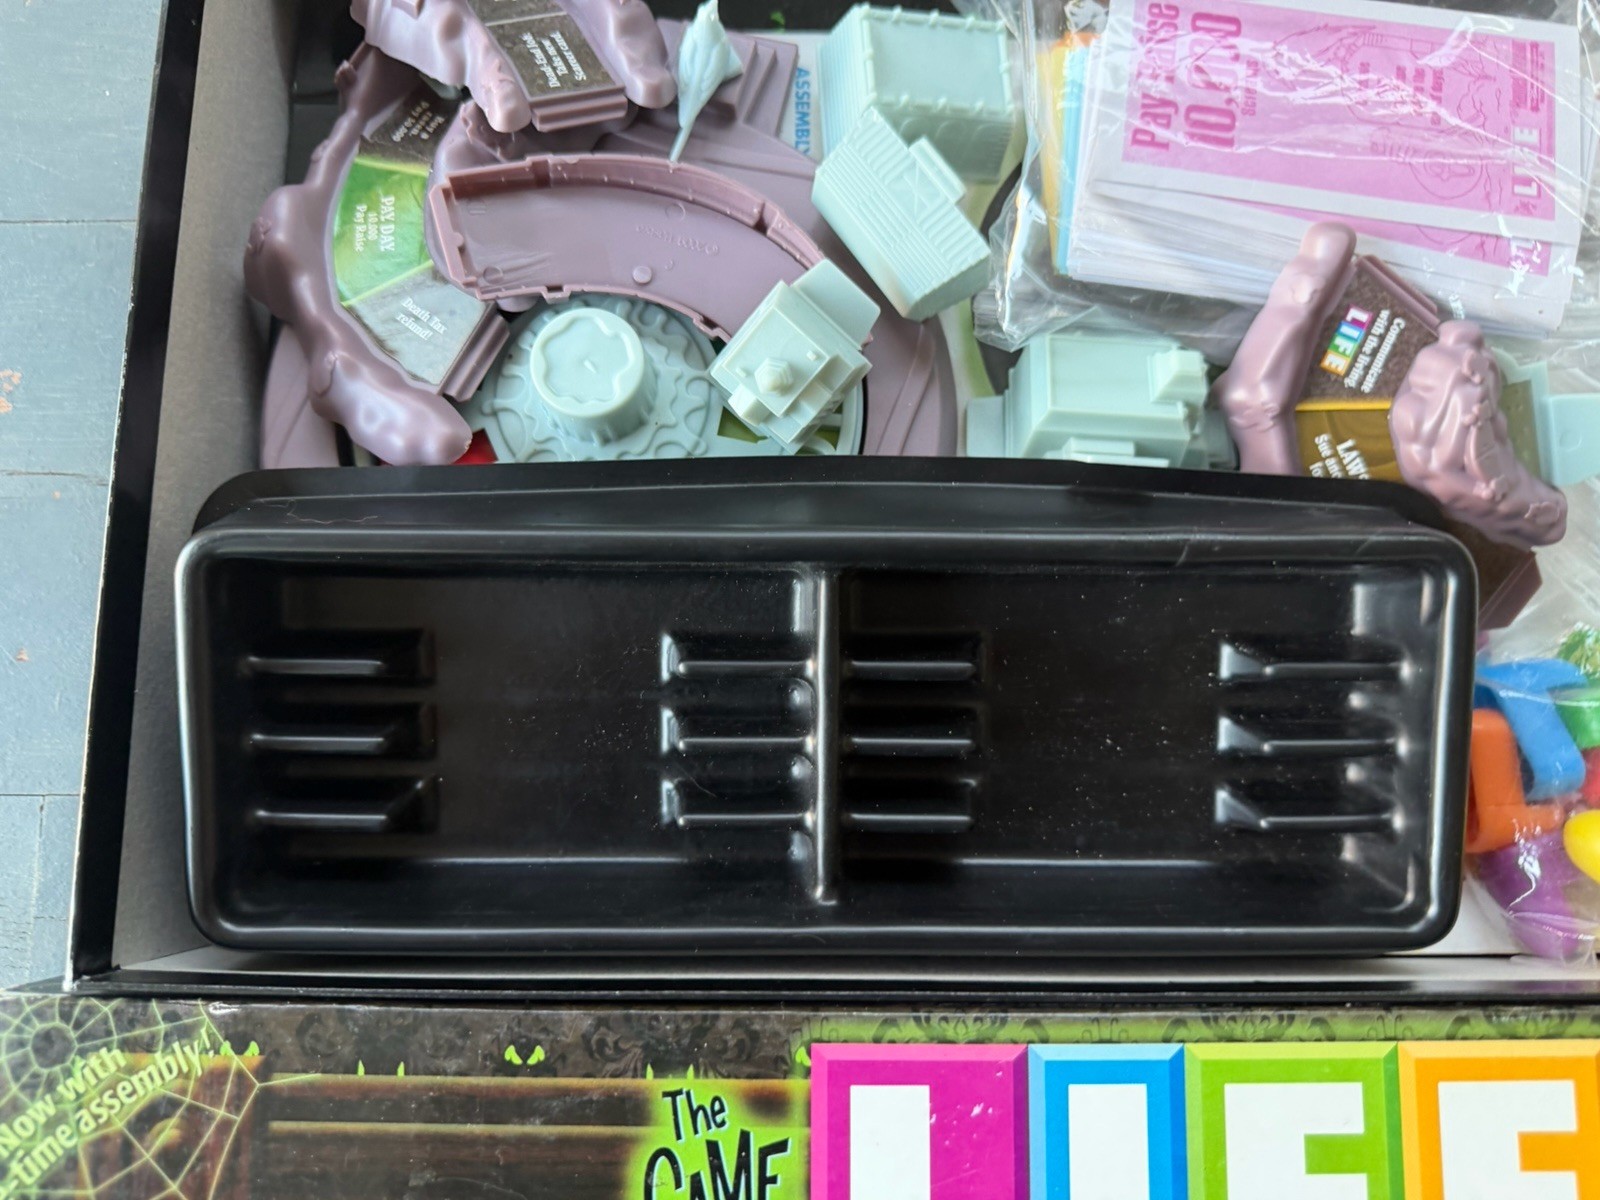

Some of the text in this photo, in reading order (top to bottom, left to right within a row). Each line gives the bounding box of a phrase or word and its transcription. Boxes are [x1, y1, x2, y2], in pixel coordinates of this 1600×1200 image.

[1131, 92, 1179, 150] Pay
[353, 204, 368, 252] Pay Raise
[380, 195, 396, 252] PAY DAY
[396, 312, 434, 341] refund!
[401, 297, 448, 335] Death Tax
[1321, 306, 1371, 375] LIFE
[1371, 309, 1391, 336] with
[1361, 317, 1406, 394] Communicate
[1362, 334, 1380, 355] the
[1314, 432, 1333, 459] Sue
[0, 1046, 127, 1159] Now with
[661, 1087, 729, 1143] The
